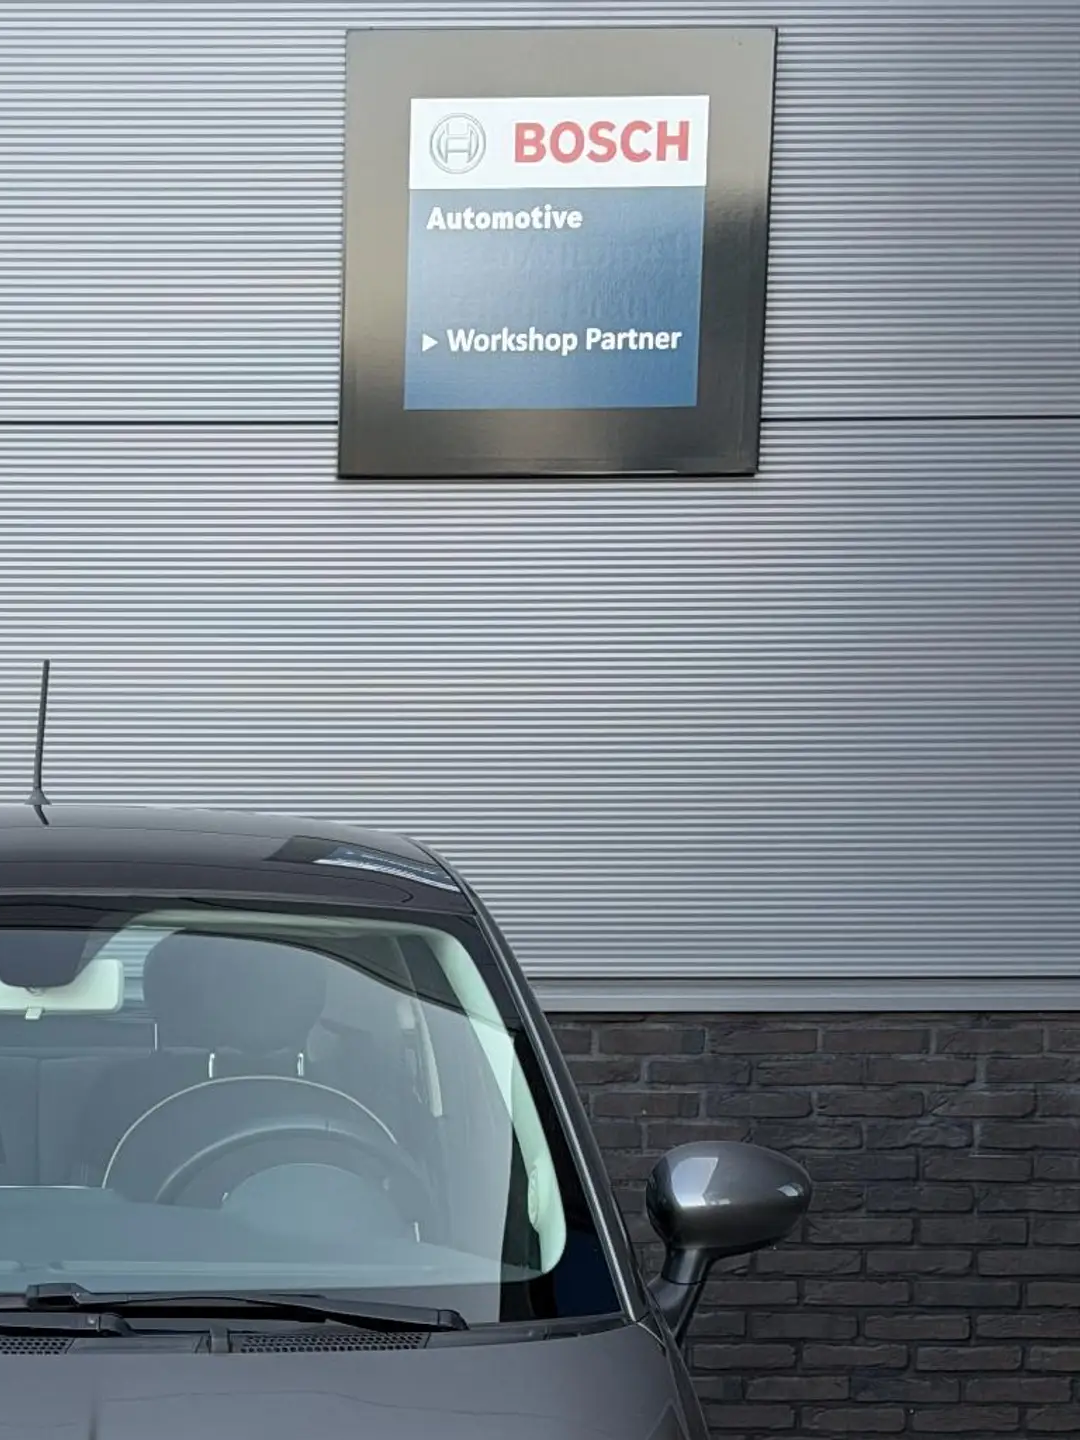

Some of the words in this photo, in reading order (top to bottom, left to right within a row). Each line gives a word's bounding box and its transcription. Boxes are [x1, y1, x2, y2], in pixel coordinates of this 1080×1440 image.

[514, 120, 690, 163] BOSCH
[426, 203, 583, 231] Automotive
[447, 327, 578, 356] Workshop
[585, 327, 682, 351] Partner
